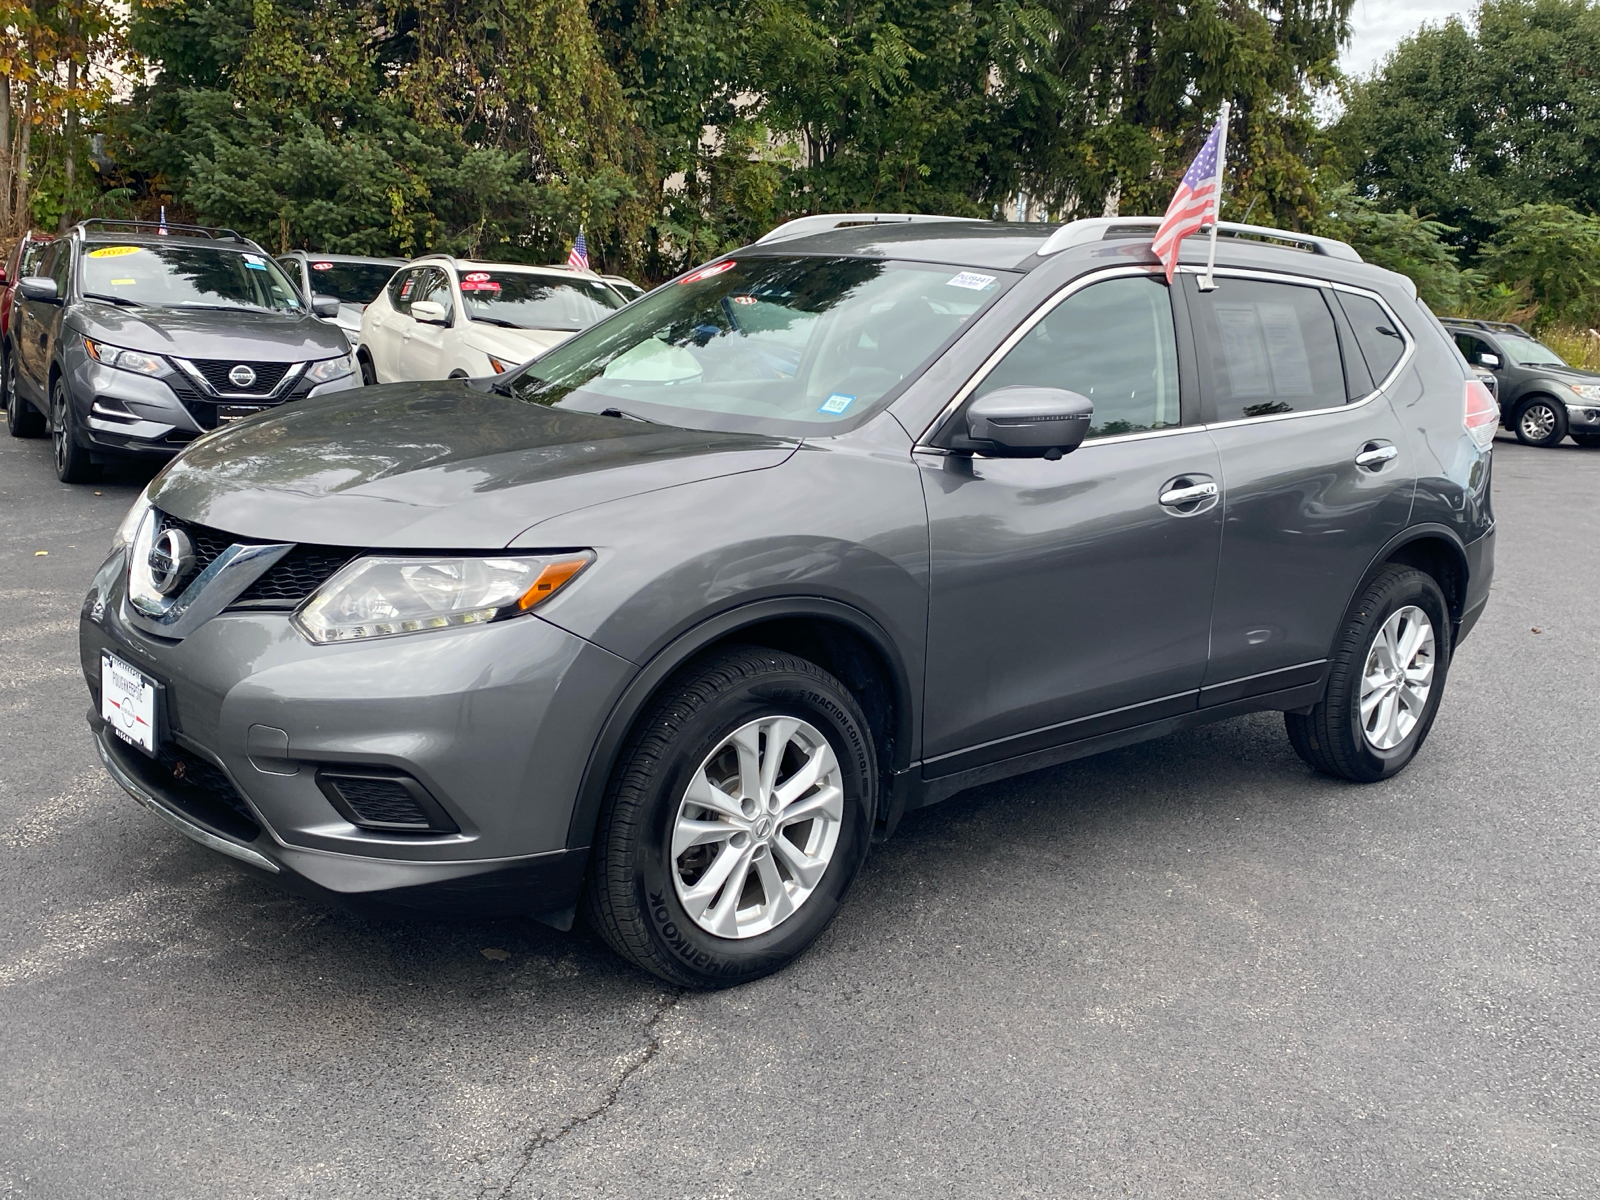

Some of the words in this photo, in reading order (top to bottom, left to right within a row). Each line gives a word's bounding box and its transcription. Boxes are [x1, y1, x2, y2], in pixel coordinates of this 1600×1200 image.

[99, 248, 131, 257] 2022
[112, 671, 143, 703] POUGHKEEPSIE
[115, 728, 133, 746] NISSAN
[807, 691, 849, 726] TRACTION
[845, 724, 868, 776] CONTROL
